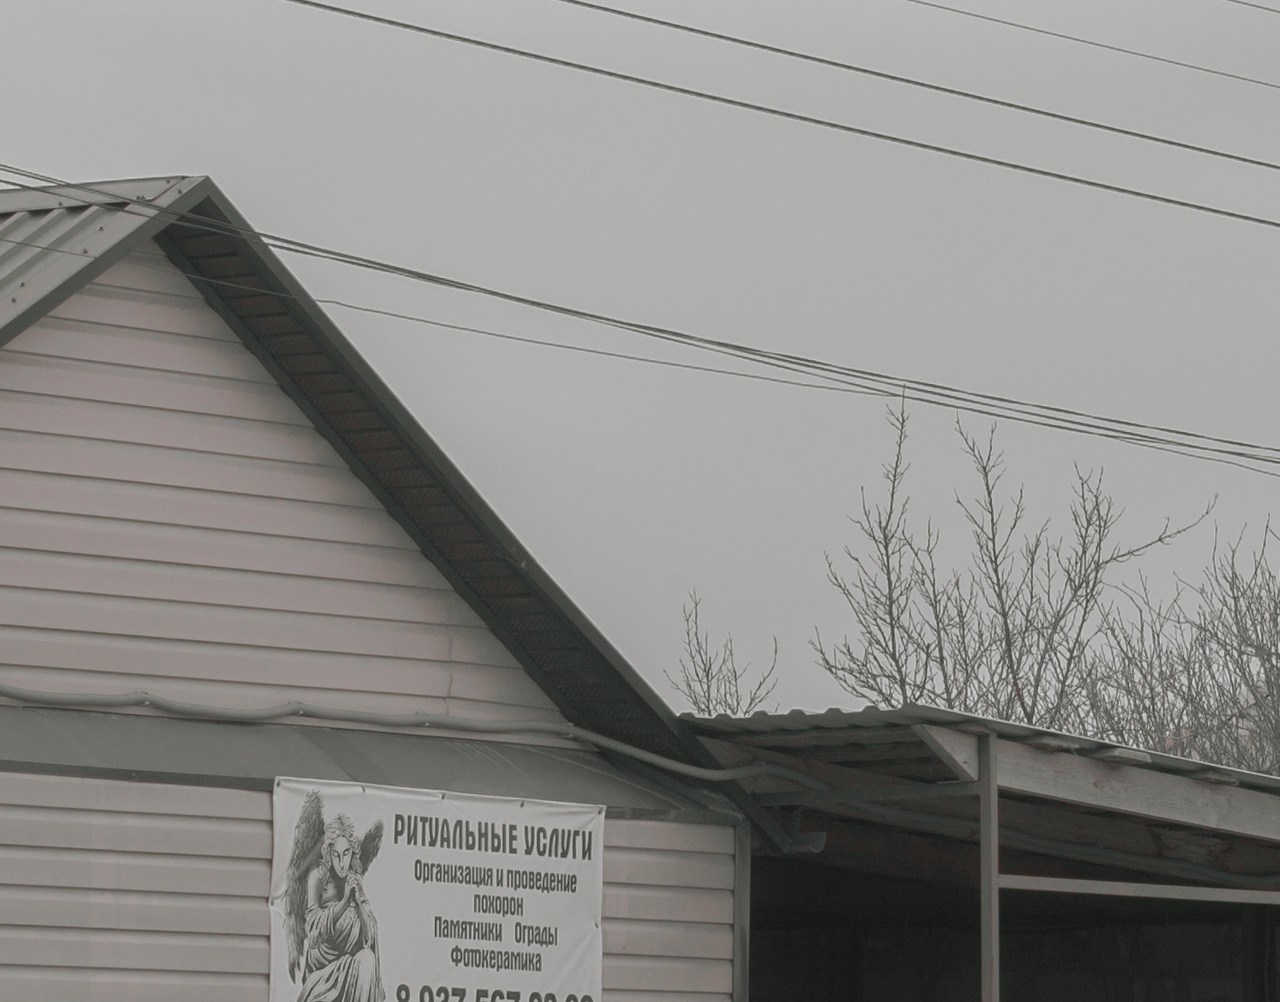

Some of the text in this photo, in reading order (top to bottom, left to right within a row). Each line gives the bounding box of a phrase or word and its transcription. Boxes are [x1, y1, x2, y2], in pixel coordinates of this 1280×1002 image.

[393, 813, 593, 861] РИТУАЛЬНЫЕ УСЛУГИ
[414, 859, 577, 894] Организация и проведение
[473, 894, 524, 916] похорон
[434, 916, 558, 946] Памятники Ограды
[450, 945, 542, 972] Фотокерамика
